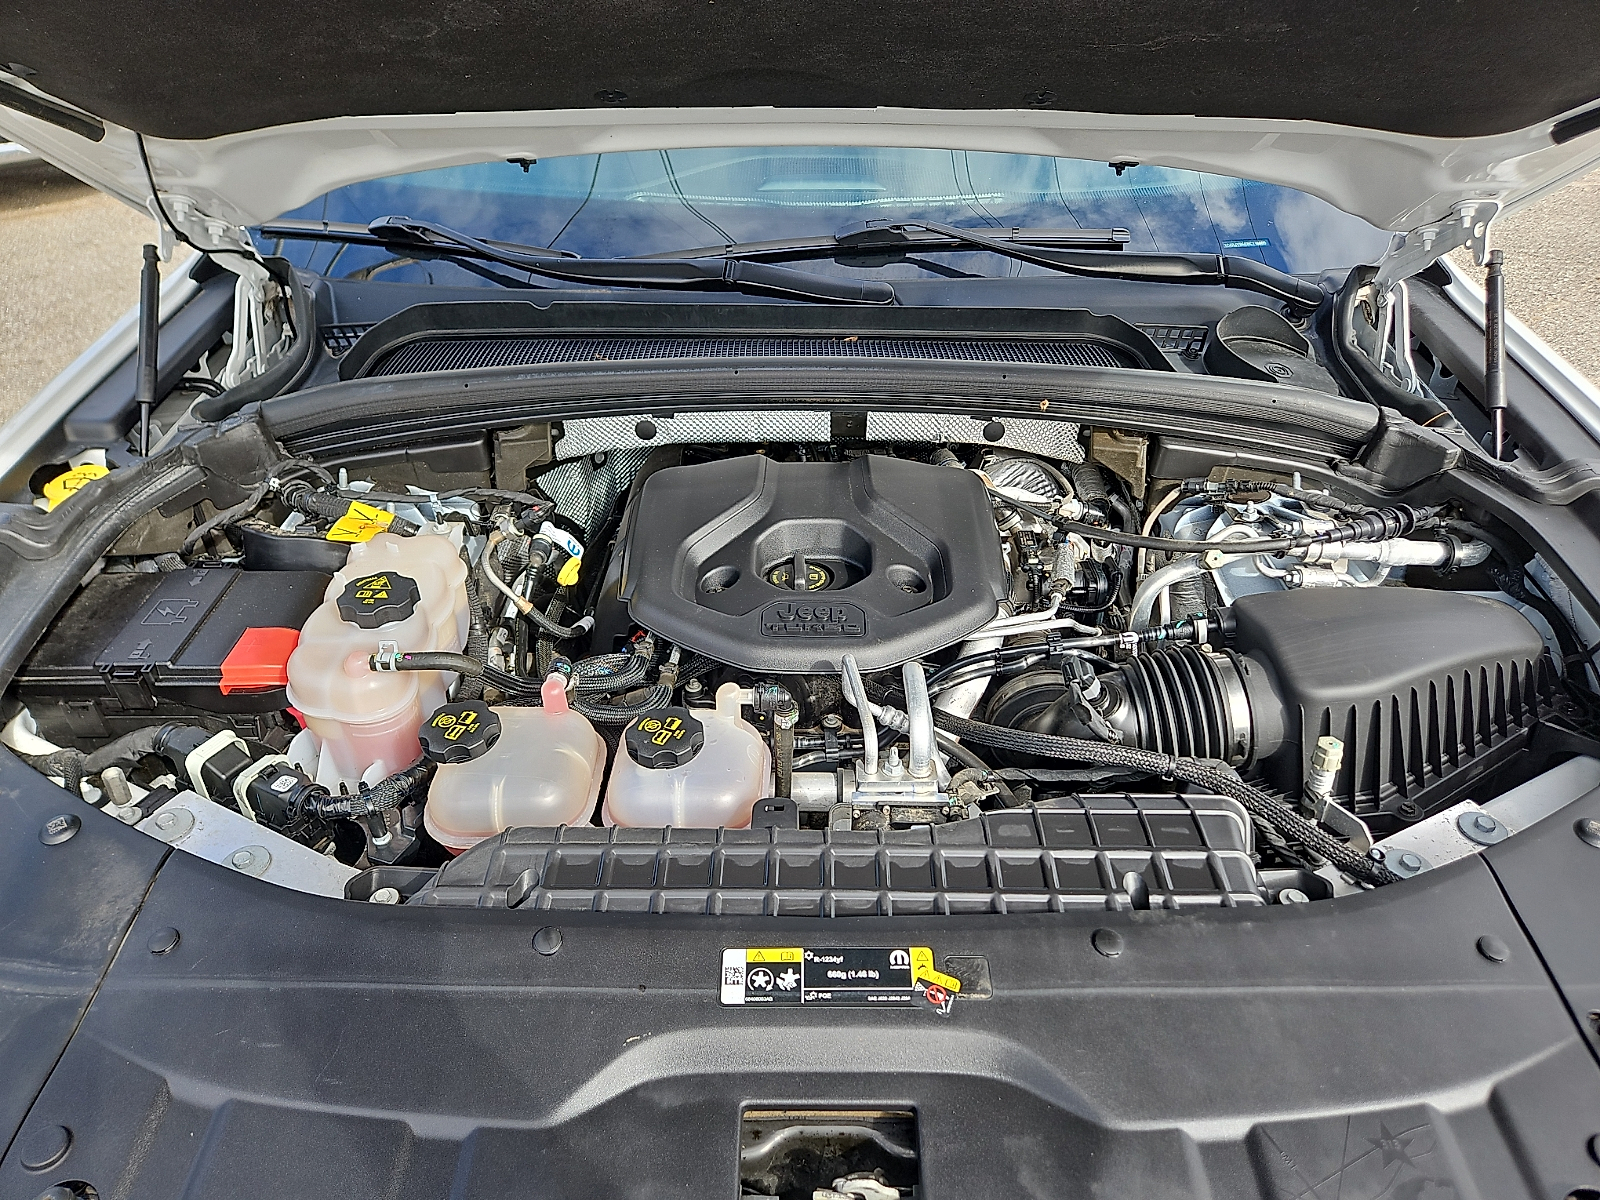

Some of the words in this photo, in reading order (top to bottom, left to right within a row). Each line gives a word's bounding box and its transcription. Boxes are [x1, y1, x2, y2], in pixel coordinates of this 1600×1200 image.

[777, 603, 848, 623] Jeep
[813, 955, 844, 964] R-1234yf
[1380, 1139, 1401, 1151] 313
